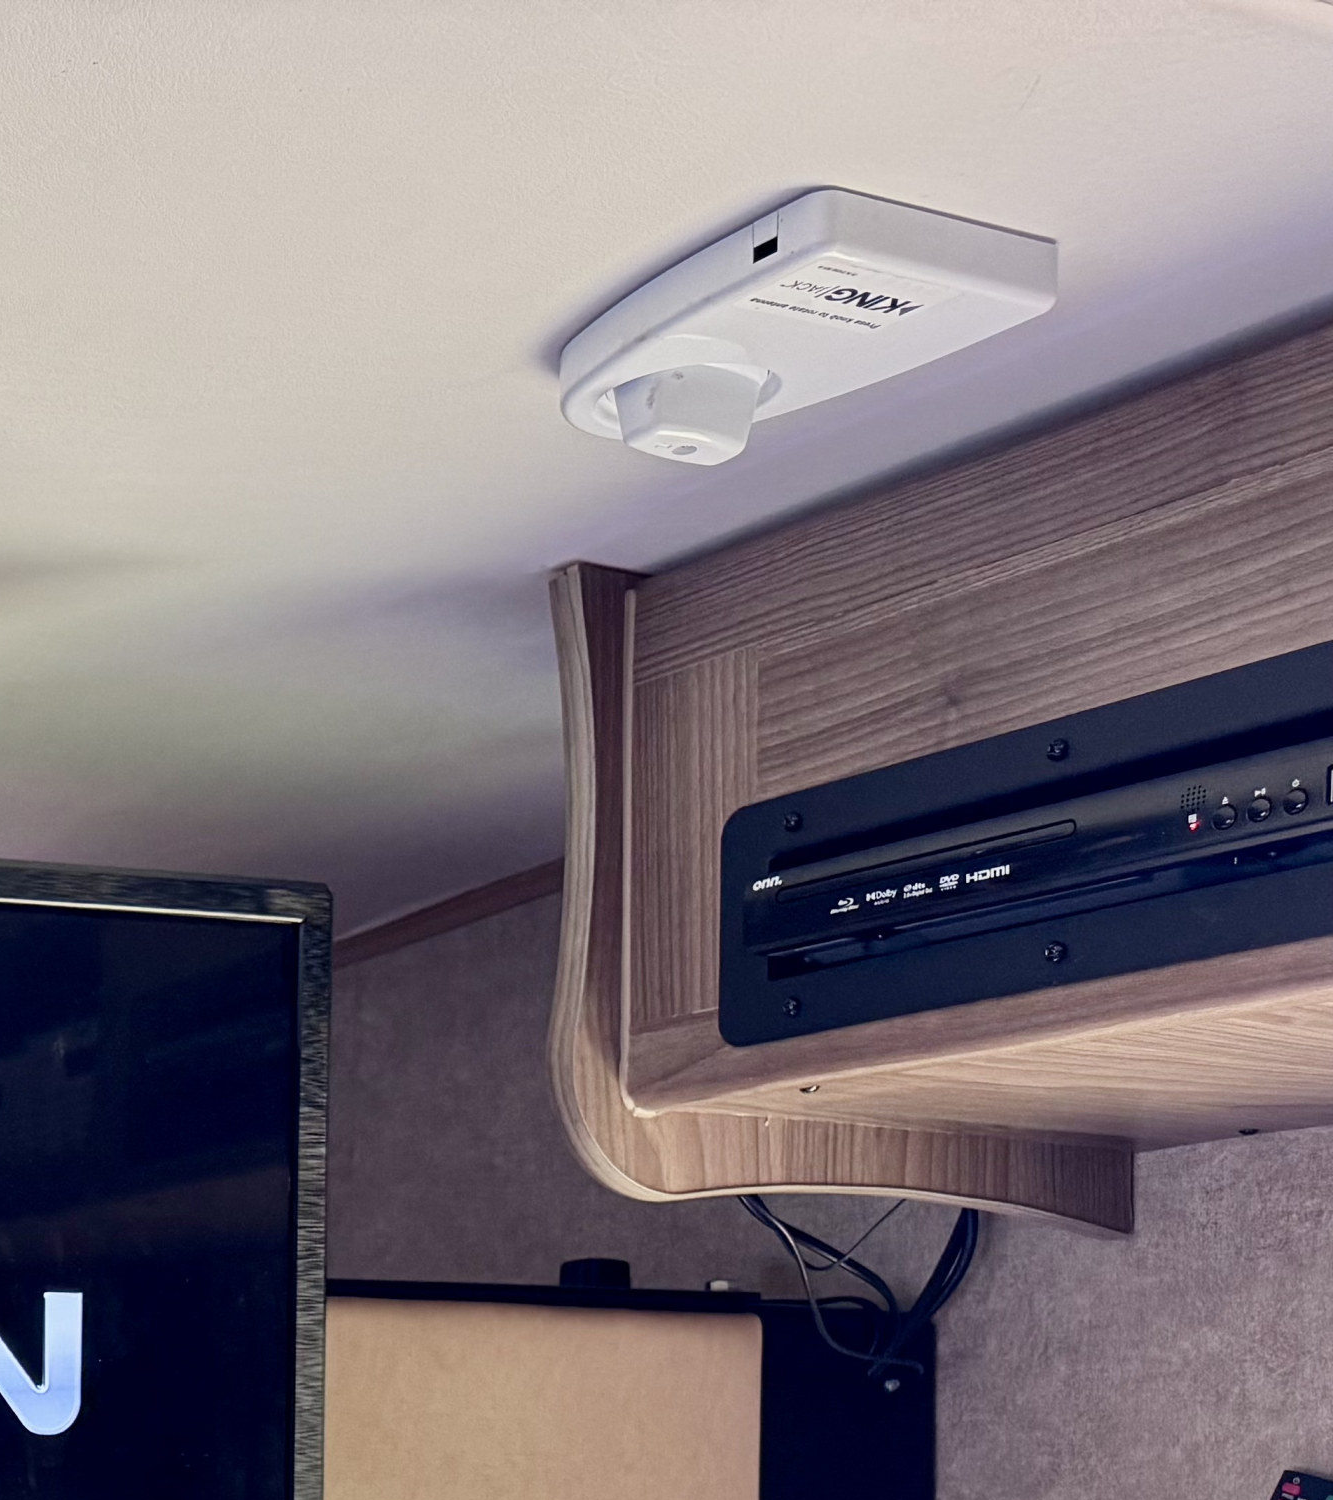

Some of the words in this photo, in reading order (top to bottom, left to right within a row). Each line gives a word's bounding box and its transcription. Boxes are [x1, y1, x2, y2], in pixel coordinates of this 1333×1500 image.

[824, 287, 912, 314] KING
[939, 873, 960, 885] DVD
[965, 864, 1011, 884] HDMI
[875, 888, 898, 901] Dolby
